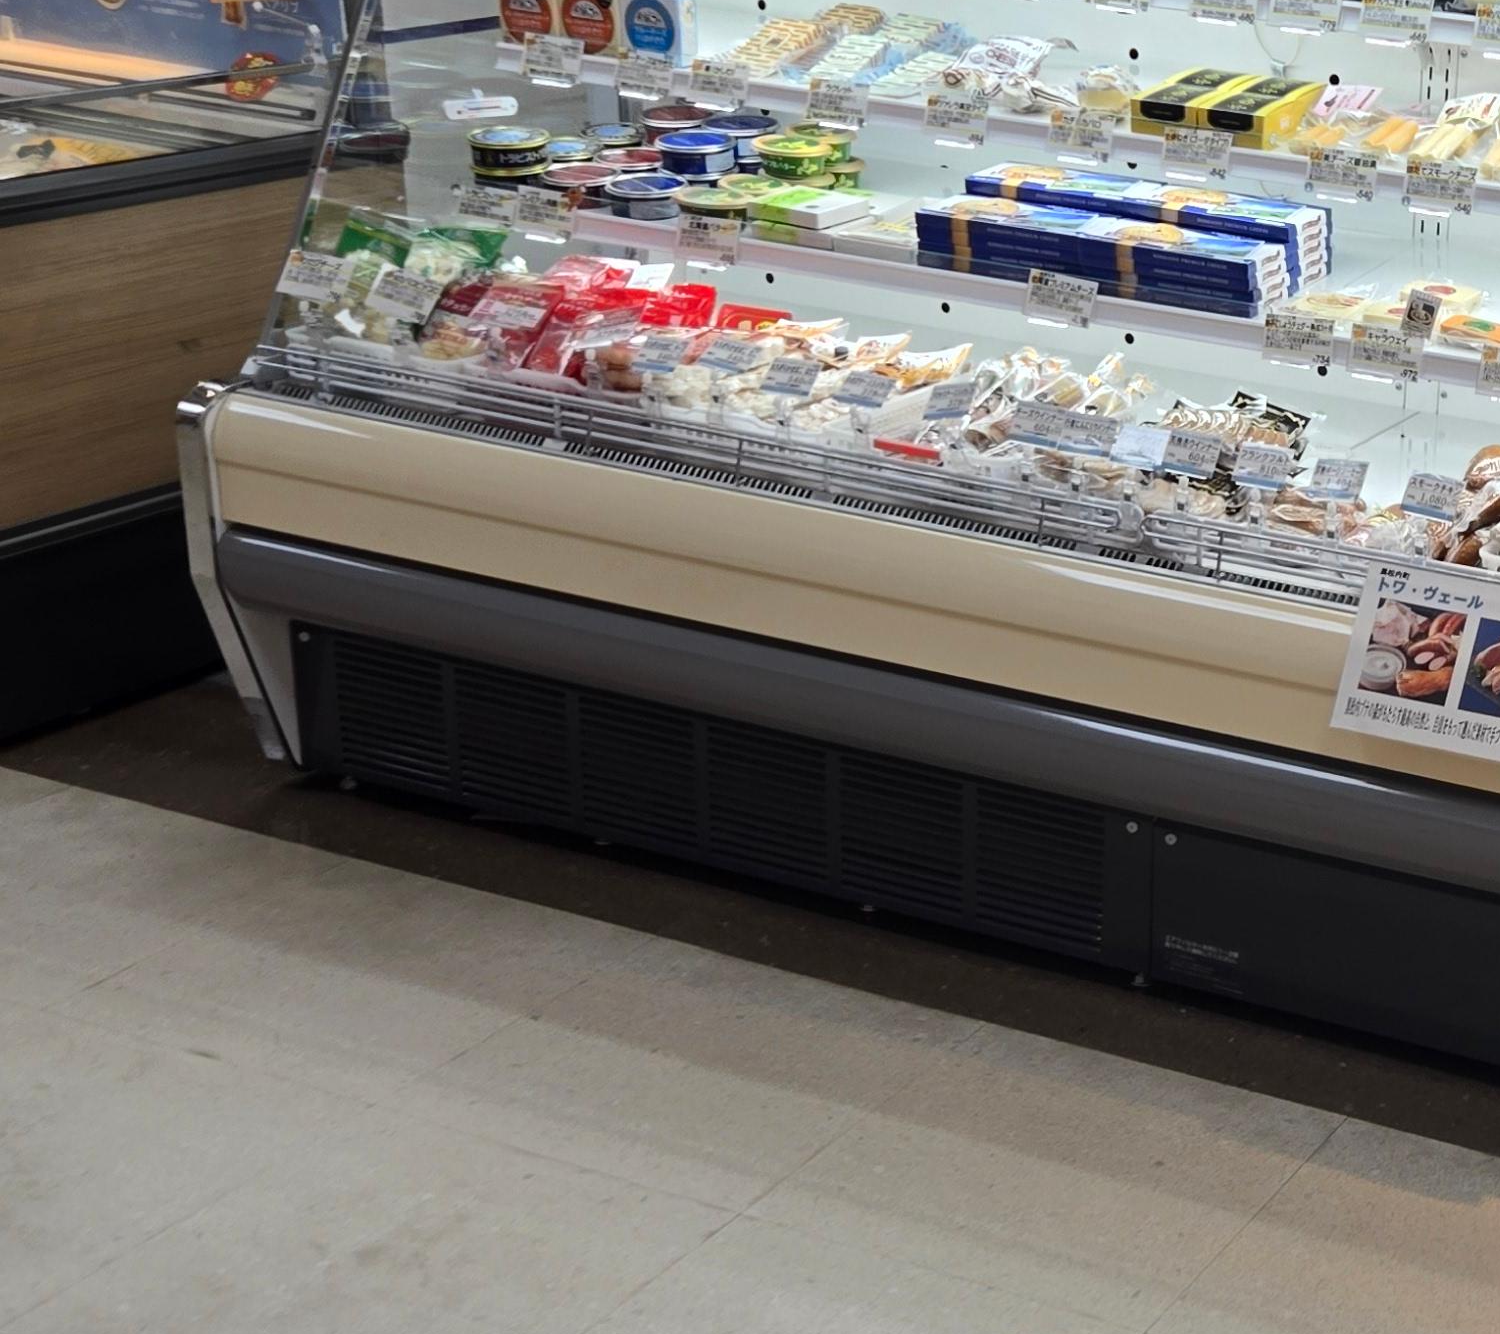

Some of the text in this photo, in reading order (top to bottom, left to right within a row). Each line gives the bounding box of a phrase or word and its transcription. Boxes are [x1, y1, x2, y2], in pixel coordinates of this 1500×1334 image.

[1367, 331, 1409, 346] キャラウェイ
[1419, 494, 1448, 507] 1,080
[1379, 567, 1411, 582] 黒松内町
[1377, 577, 1484, 610] トワ・ヴェール
